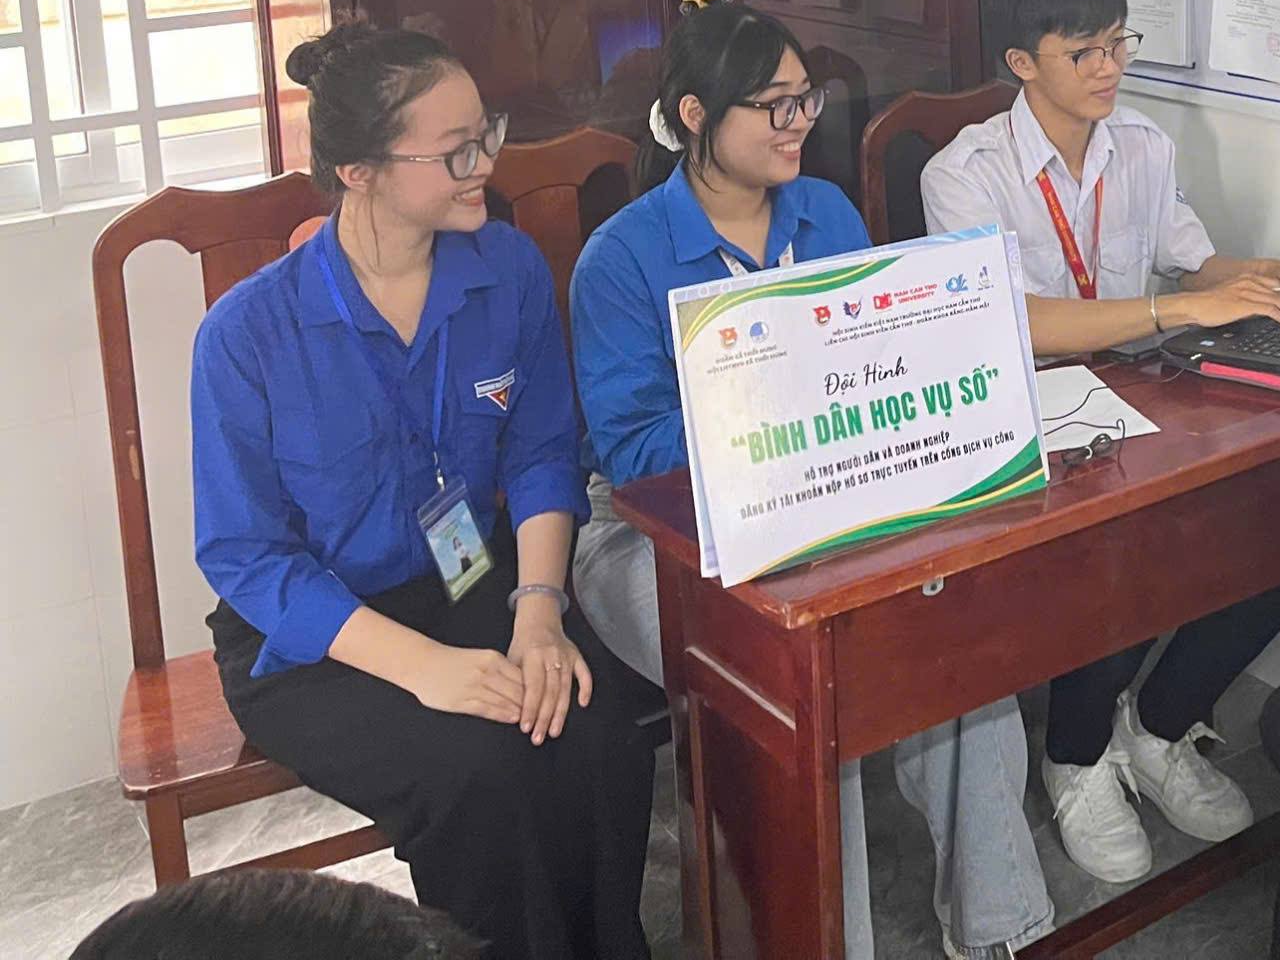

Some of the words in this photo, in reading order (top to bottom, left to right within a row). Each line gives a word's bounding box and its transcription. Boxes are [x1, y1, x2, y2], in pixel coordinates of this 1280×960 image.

[894, 289, 909, 297] NAM
[898, 291, 935, 304] UNIVERSITY
[824, 371, 858, 396] Đội
[864, 356, 908, 387] Hình
[813, 401, 864, 445] DÂN
[869, 391, 917, 432] HỌC
[921, 380, 952, 418] VỤ
[818, 463, 834, 479] TRỢ
[836, 454, 862, 472] NGƯỜI
[864, 450, 880, 465] DÂN
[882, 442, 893, 459] VÀ
[895, 440, 921, 456] DOANH
[923, 430, 950, 447] NGHIỆP
[826, 480, 842, 495] NỘP
[858, 471, 869, 485] SƠ
[871, 465, 892, 480] TRỰC
[894, 456, 918, 474] TUYẾN
[920, 451, 939, 467] TRÊN
[983, 437, 993, 450] VỤ
[995, 430, 1015, 445] CÔNG
